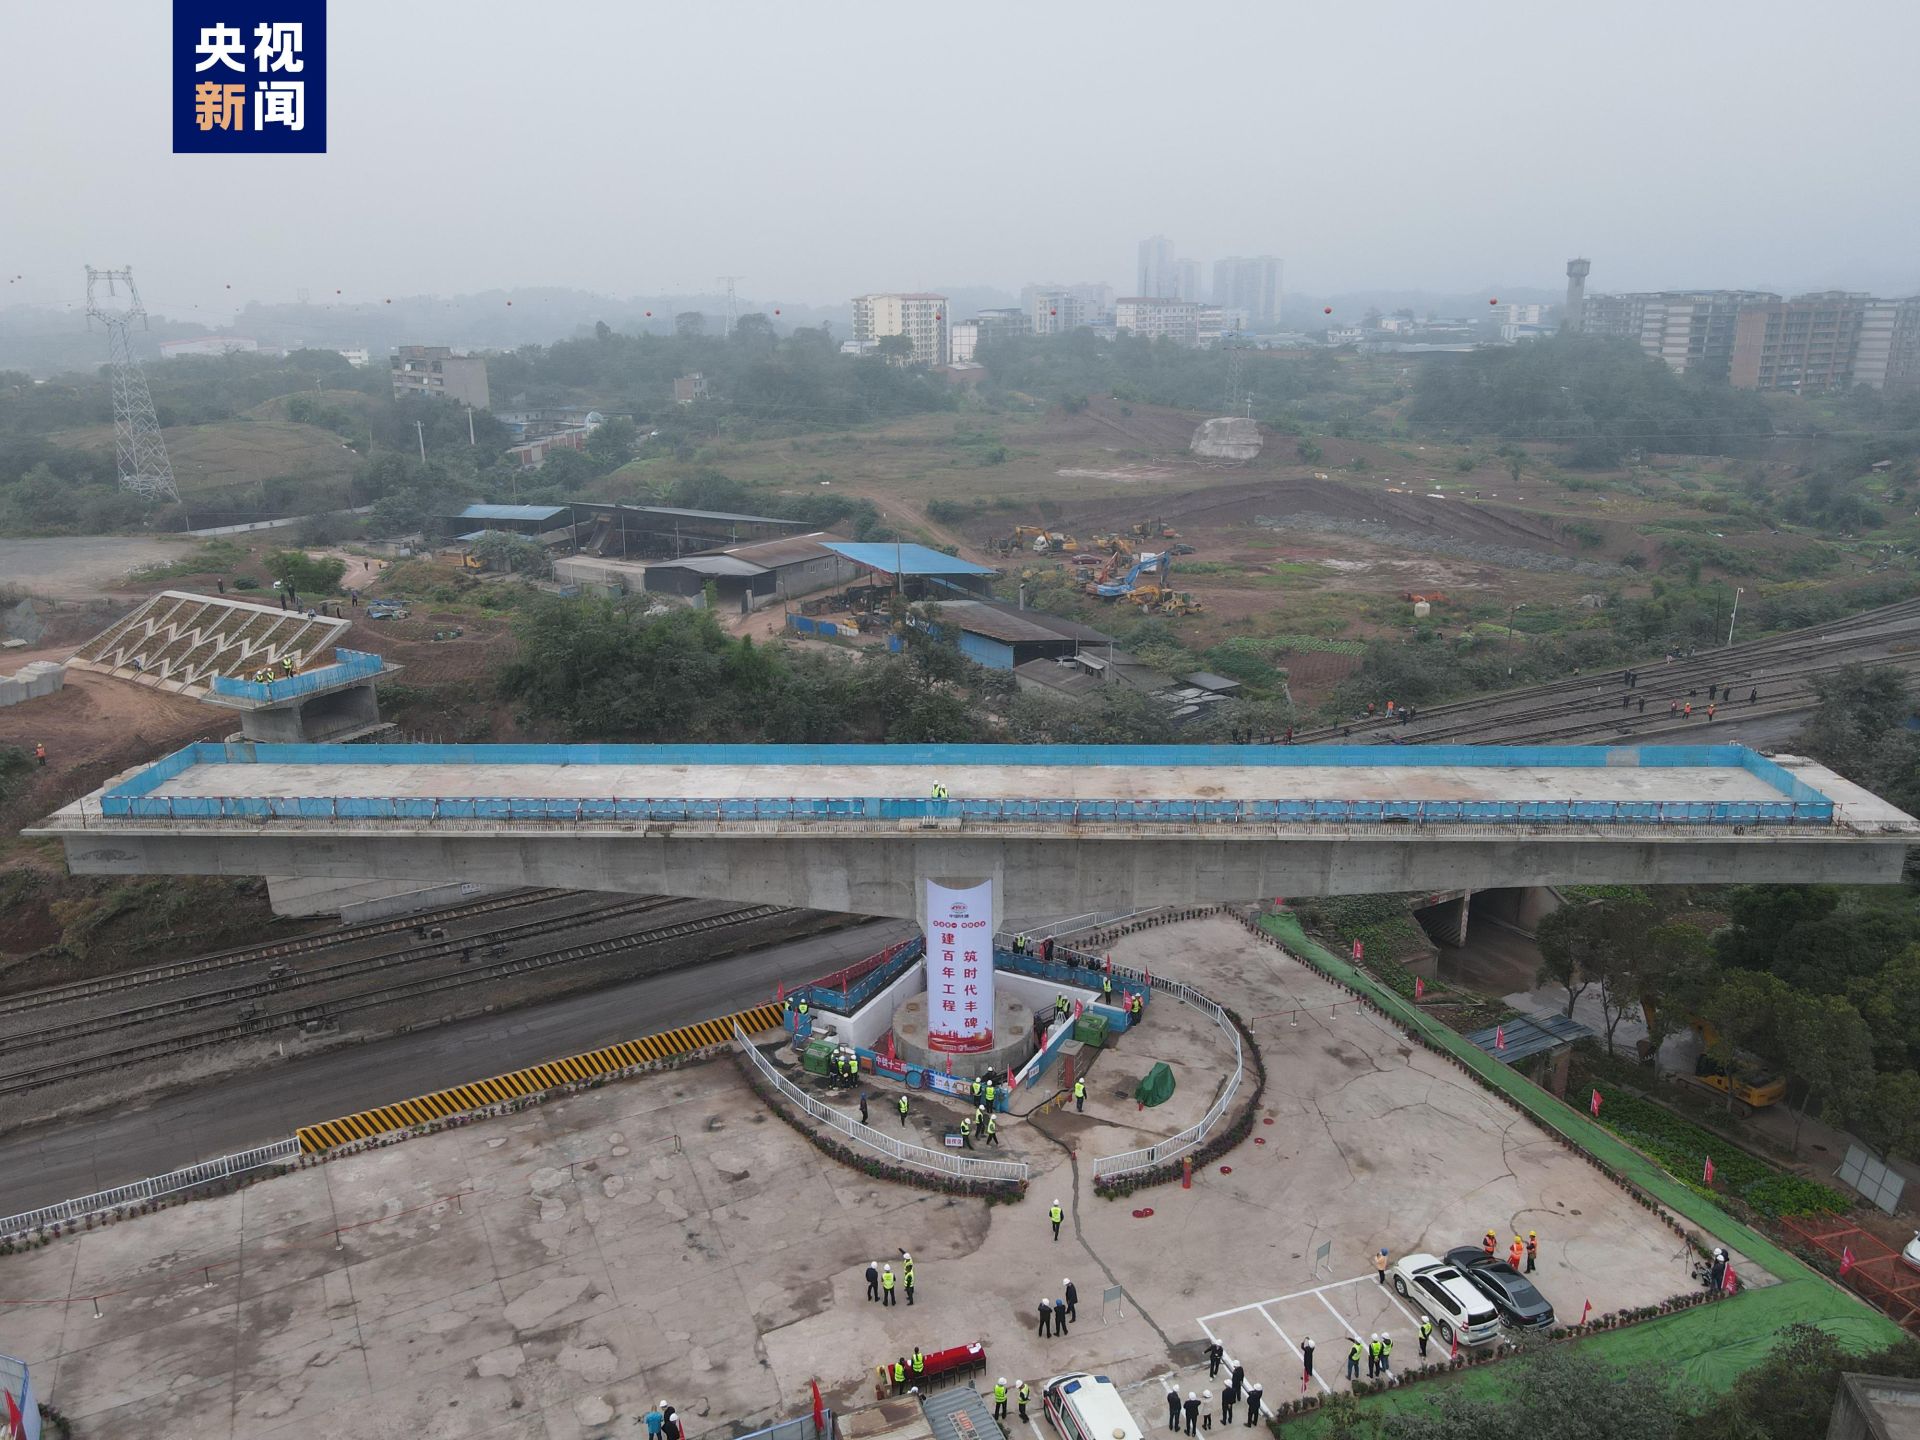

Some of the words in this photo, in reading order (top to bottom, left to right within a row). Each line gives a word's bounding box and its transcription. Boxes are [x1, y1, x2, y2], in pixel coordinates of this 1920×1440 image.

[941, 933, 956, 1012] 建百年工程
[964, 951, 978, 1029] 筑时代丰碑
